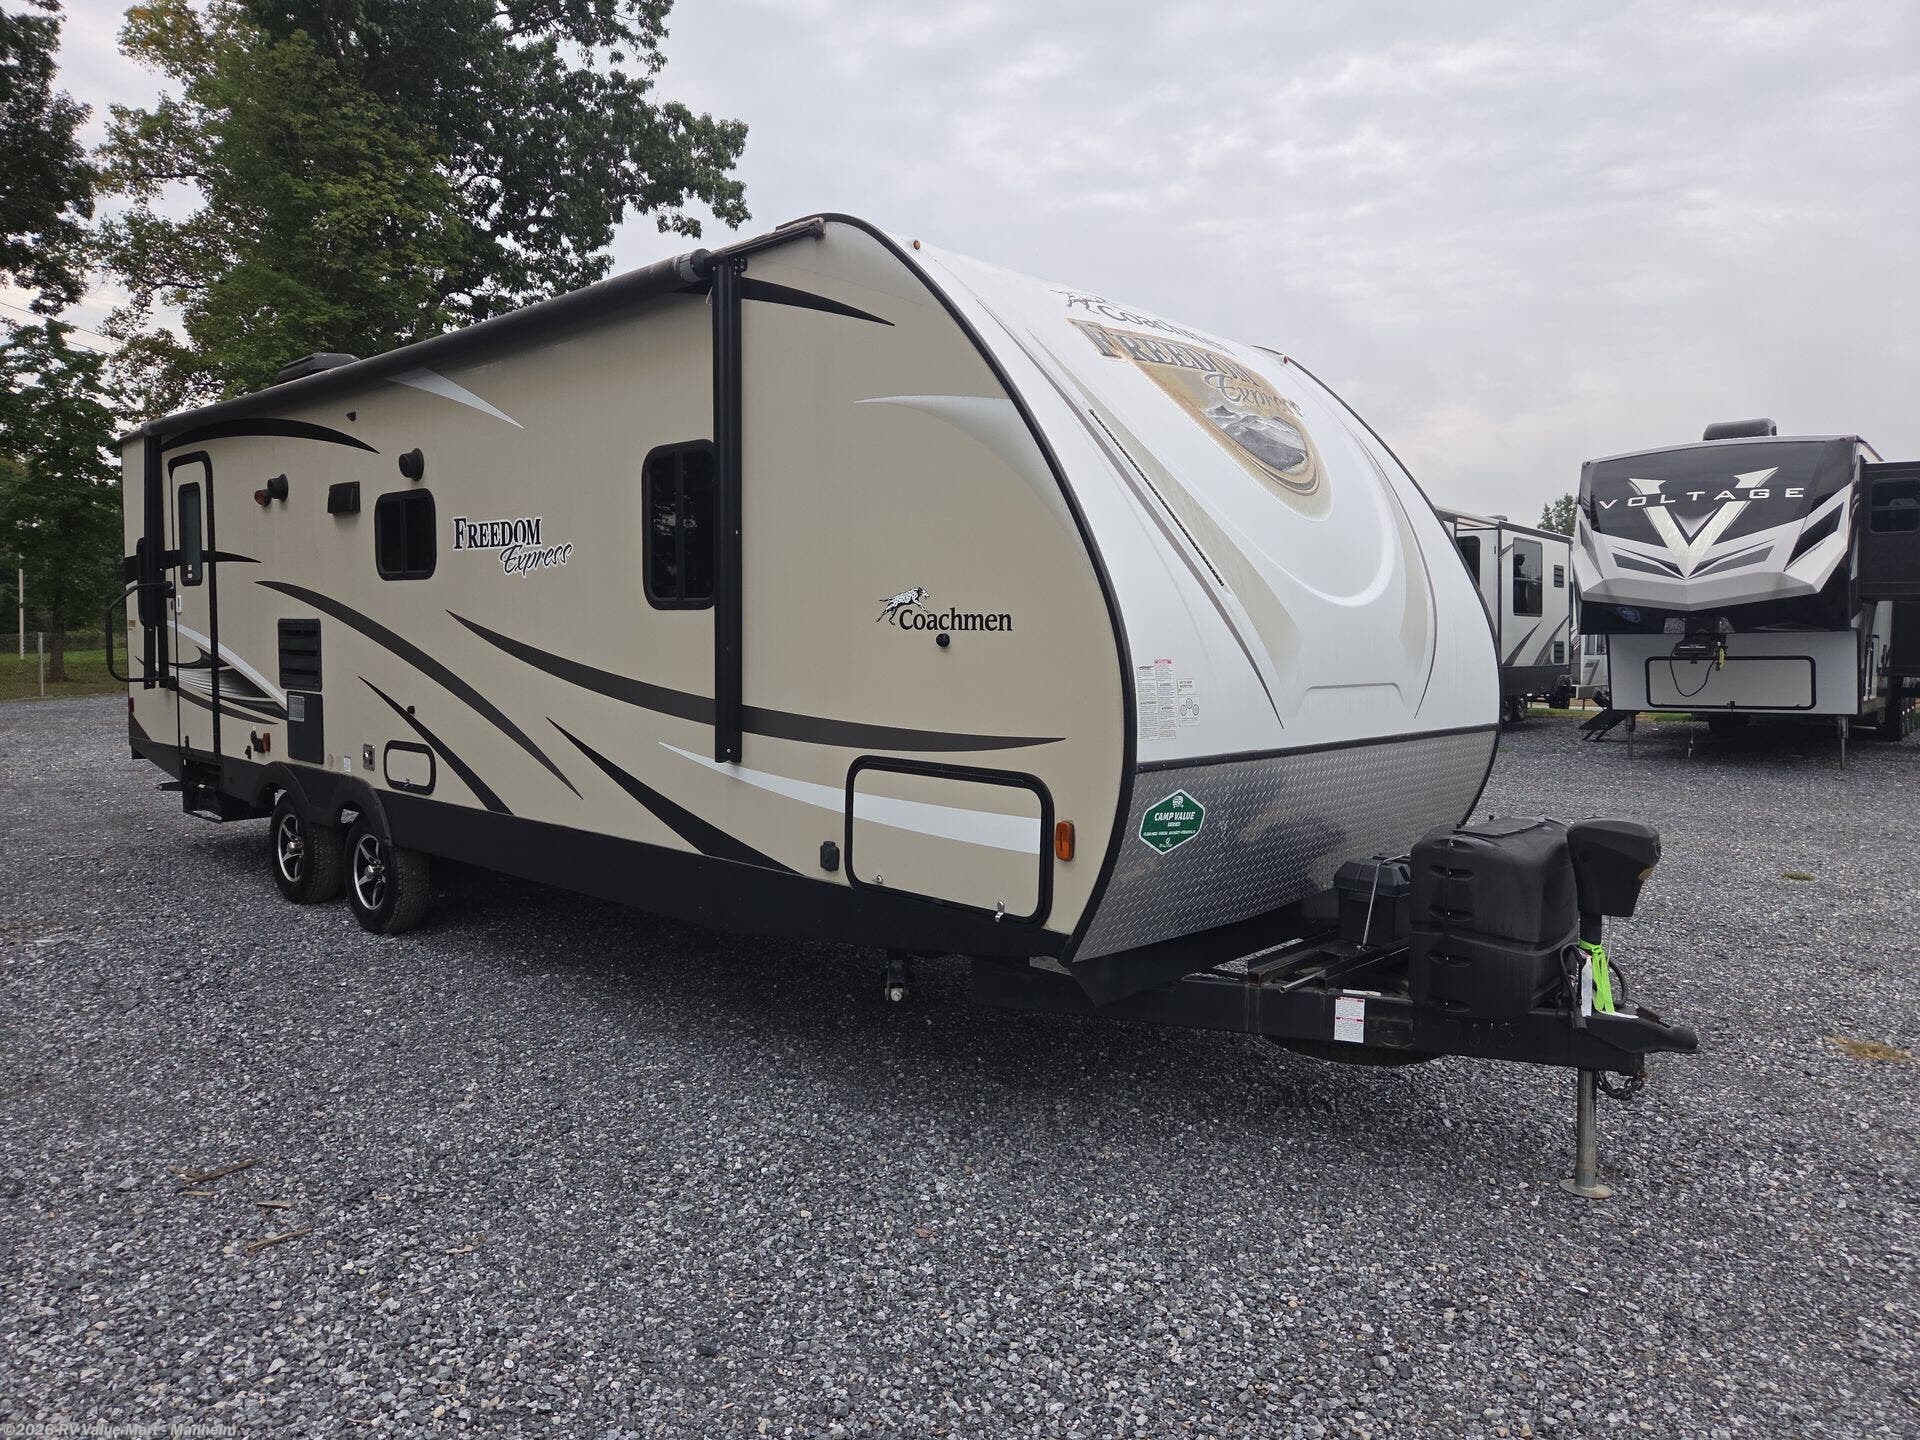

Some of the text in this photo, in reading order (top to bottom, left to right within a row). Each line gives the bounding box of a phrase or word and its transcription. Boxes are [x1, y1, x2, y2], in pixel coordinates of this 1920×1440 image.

[1599, 487, 1805, 510] VOLTAGE
[453, 518, 542, 549] FREEDOM
[499, 544, 573, 576] Express
[899, 607, 1013, 631] Coachmen
[1154, 811, 1196, 821] CAMP VALUE
